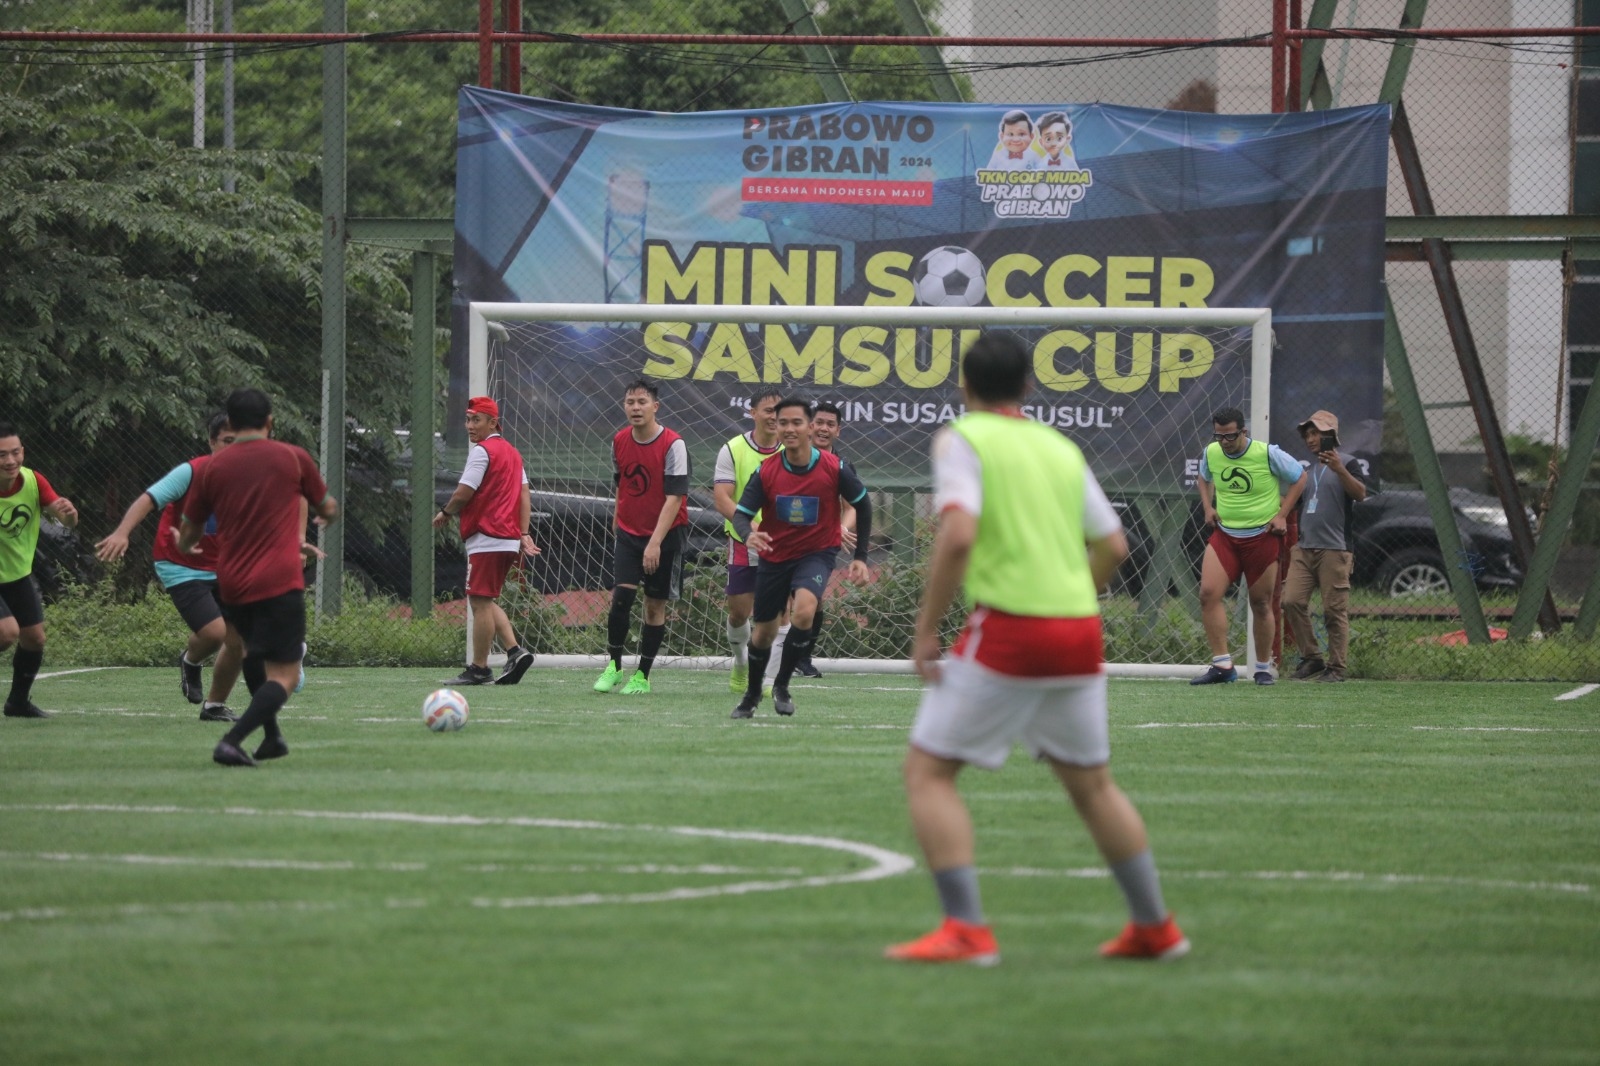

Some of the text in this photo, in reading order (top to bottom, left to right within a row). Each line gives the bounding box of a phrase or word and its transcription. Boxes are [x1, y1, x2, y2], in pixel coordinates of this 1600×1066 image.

[742, 113, 935, 144] PRABOWO
[742, 144, 933, 174] GIBRAN 2024
[748, 185, 926, 199] BERSAMA INDONESIA MAJU
[978, 171, 1090, 184] TKN GOLF MUDA
[997, 200, 1069, 216] GIBRAN
[646, 244, 837, 307] MINI
[1032, 329, 1215, 393] CUP
